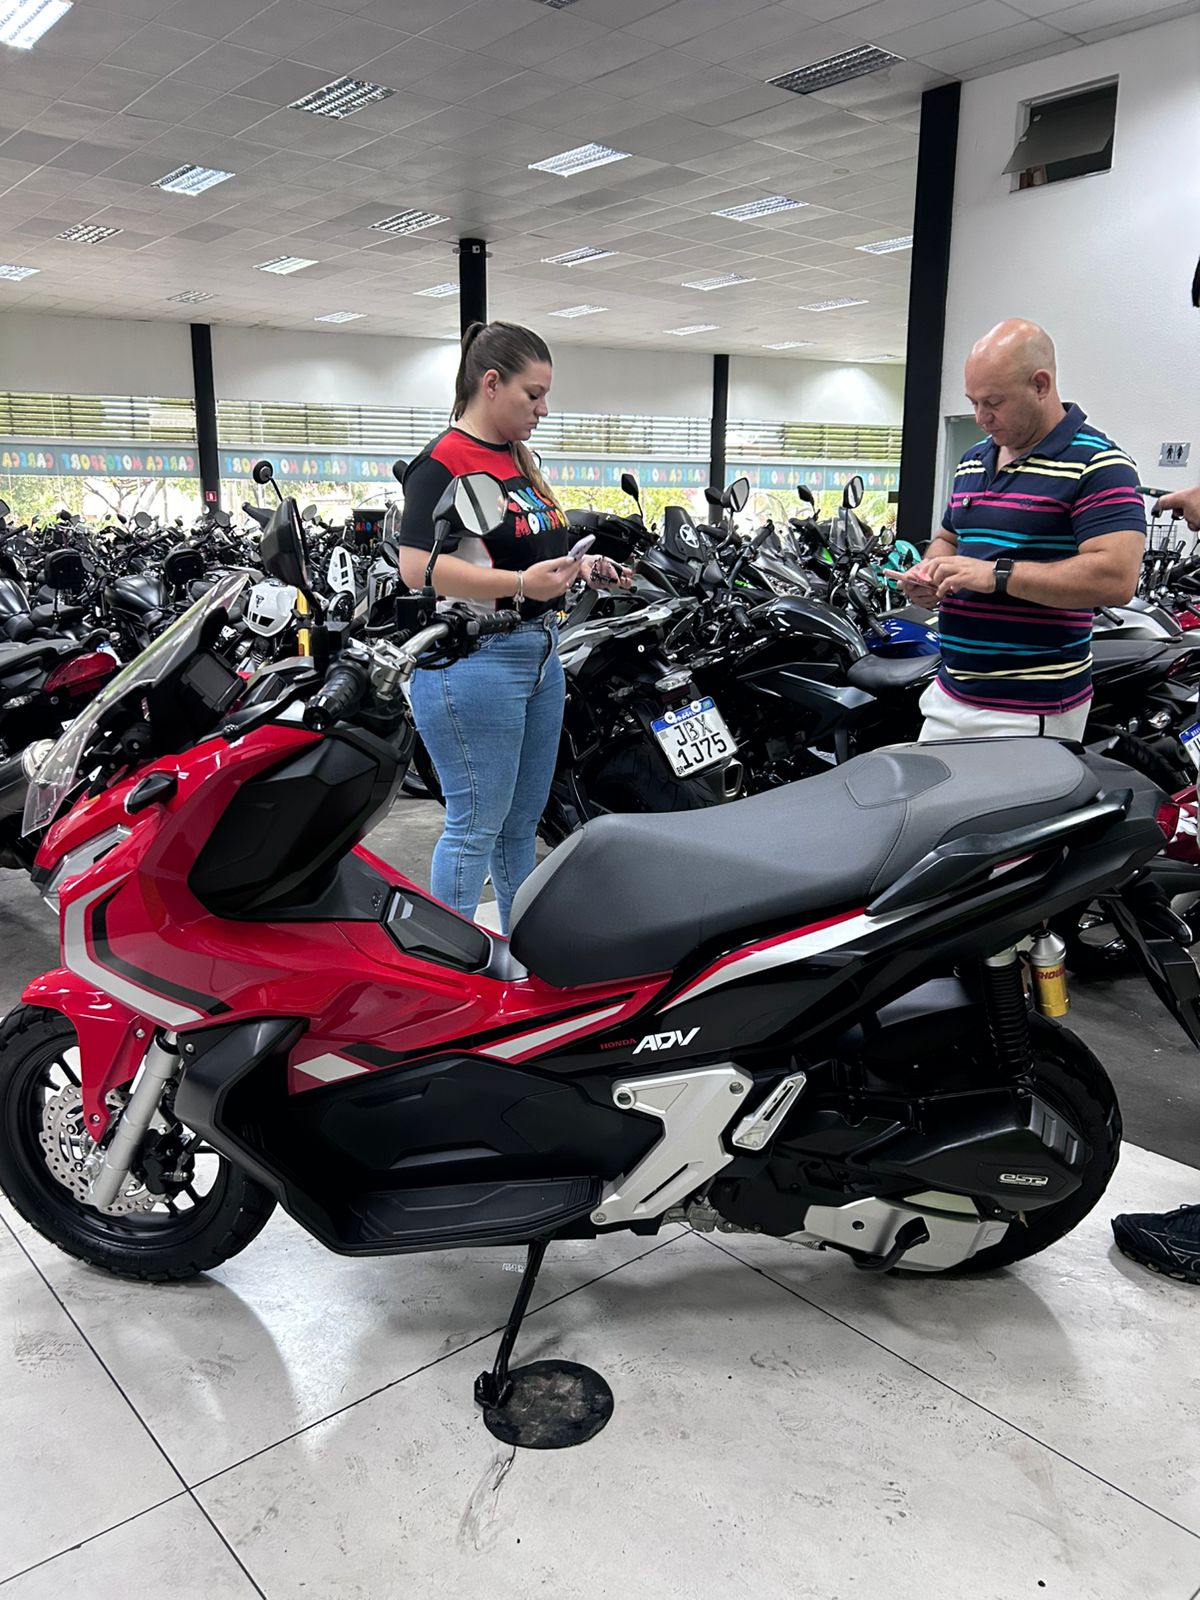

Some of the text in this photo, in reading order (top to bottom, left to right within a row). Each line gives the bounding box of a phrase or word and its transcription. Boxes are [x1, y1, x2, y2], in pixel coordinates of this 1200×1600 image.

[674, 714, 713, 746] JBX
[678, 732, 727, 769] 1J75
[600, 1026, 701, 1055] HONDA ADV
